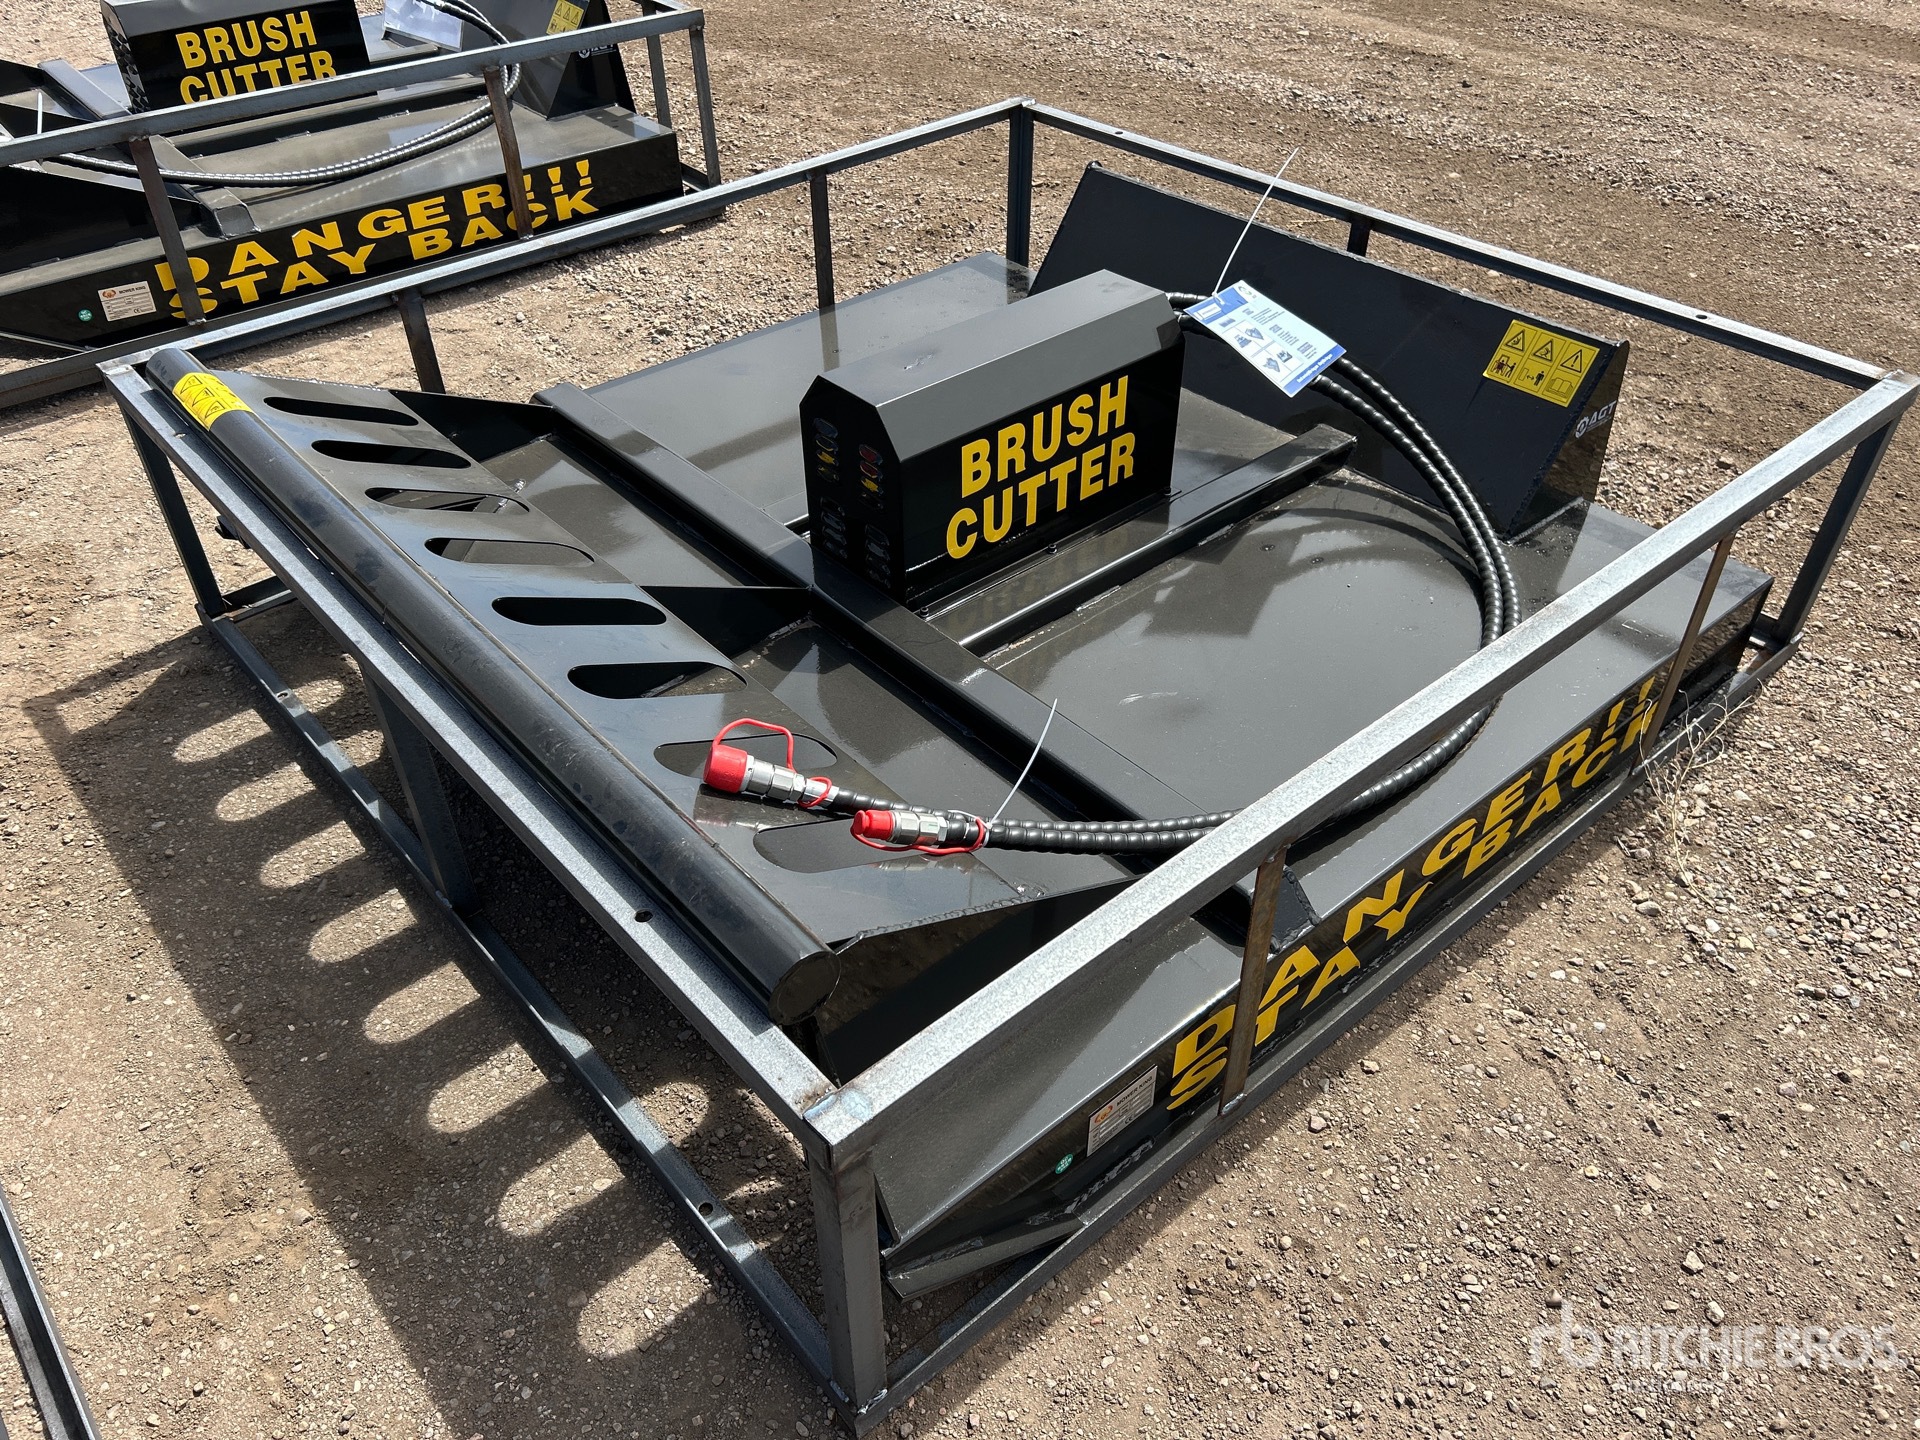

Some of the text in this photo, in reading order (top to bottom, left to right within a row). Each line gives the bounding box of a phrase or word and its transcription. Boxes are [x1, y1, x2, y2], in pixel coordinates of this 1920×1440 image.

[176, 11, 317, 69] BRUSH
[180, 50, 337, 104] CUTTER
[407, 187, 599, 261] BACK
[169, 243, 377, 318] STAY
[962, 375, 1128, 498] BRUSH
[1588, 400, 1617, 425] AGT
[947, 432, 1135, 559] CUTTER
[1463, 700, 1659, 879] BACK
[1172, 675, 1656, 1079] DANGER!!
[1166, 881, 1434, 1111] STAY
[1117, 1075, 1153, 1106] MOWER KING
